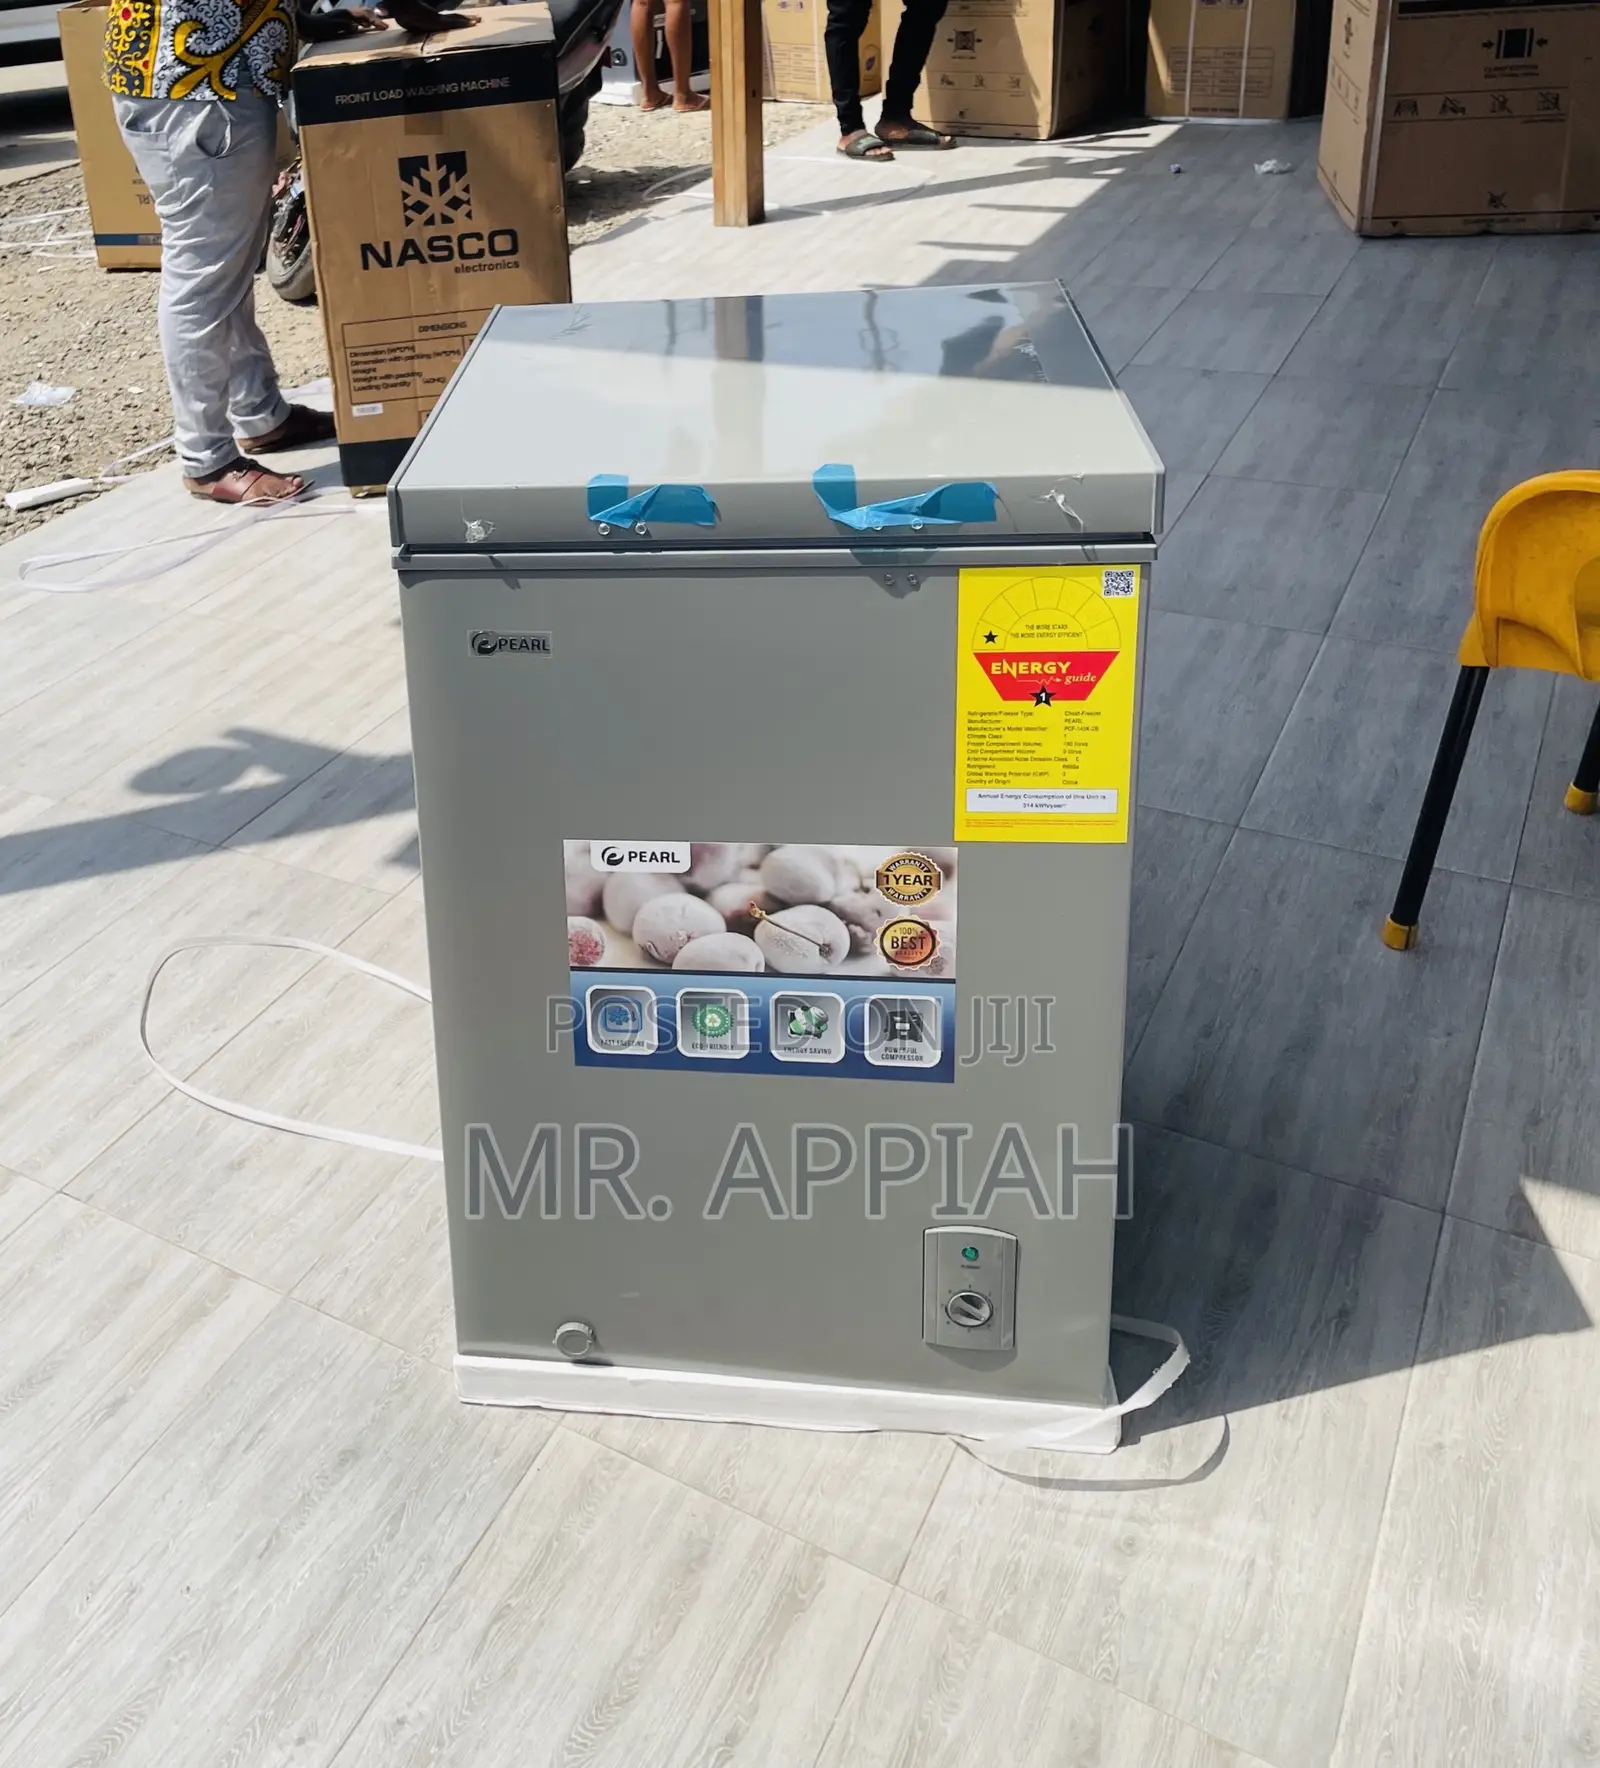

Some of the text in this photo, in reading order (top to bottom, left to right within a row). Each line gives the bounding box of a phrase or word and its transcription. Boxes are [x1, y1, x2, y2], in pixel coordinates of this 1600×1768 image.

[335, 77, 511, 104] FRONT LOAD WASHING MACHINE
[360, 228, 519, 271] NASCO
[454, 259, 520, 275] electronics
[418, 321, 467, 333] DIMENSIONS
[498, 637, 550, 651] PEARL
[991, 659, 1071, 678] ENERGY
[1064, 672, 1097, 685] guide
[1040, 693, 1046, 702] 1
[628, 850, 681, 864] PEARL
[888, 859, 930, 872] WARRANTY
[883, 874, 933, 886] 1 YEAR
[888, 888, 929, 901] WARRANTY
[891, 935, 926, 950] BEST
